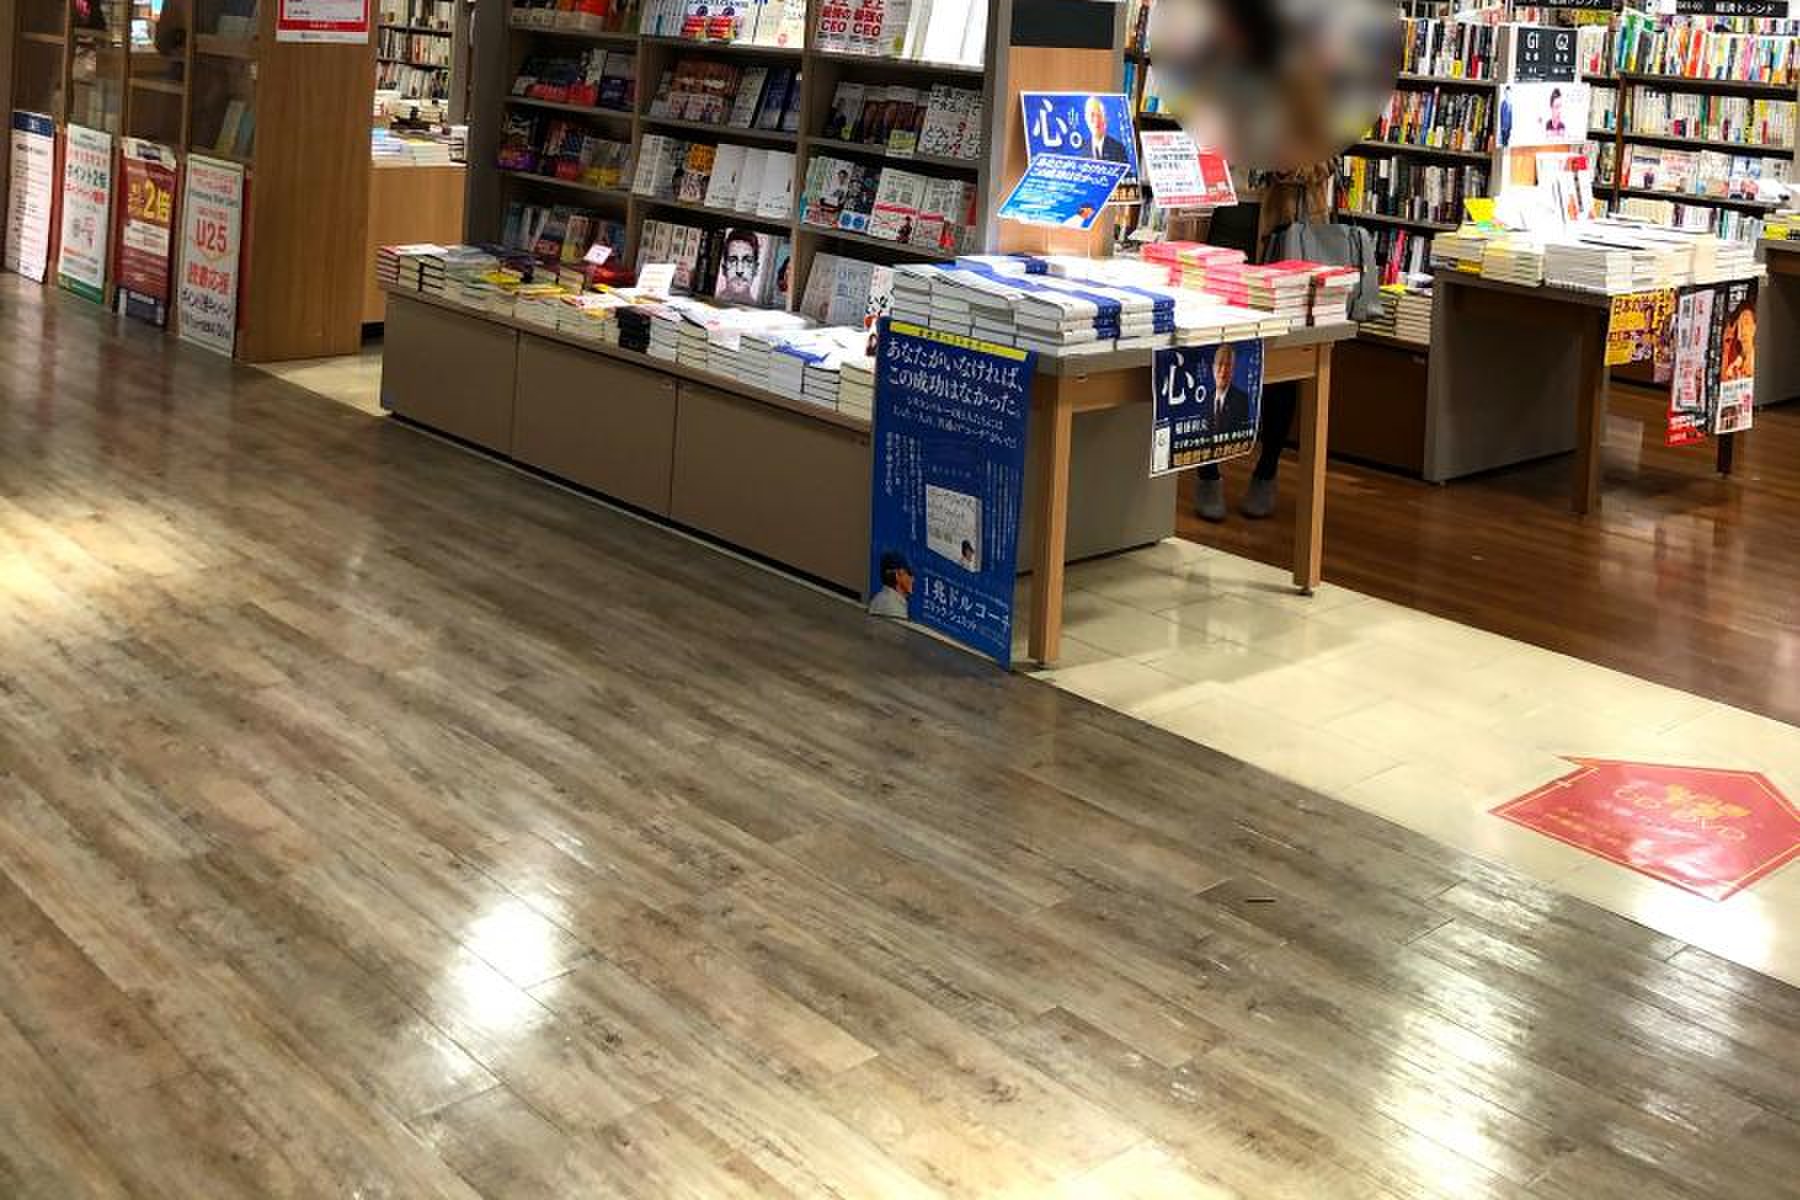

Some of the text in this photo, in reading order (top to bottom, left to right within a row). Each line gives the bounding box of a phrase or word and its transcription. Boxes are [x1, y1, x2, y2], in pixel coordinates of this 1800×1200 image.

[821, 19, 847, 33] CEO
[853, 22, 881, 37] CEO
[1033, 99, 1083, 148] 心。
[195, 217, 228, 253] U25
[1161, 351, 1207, 406] 心。
